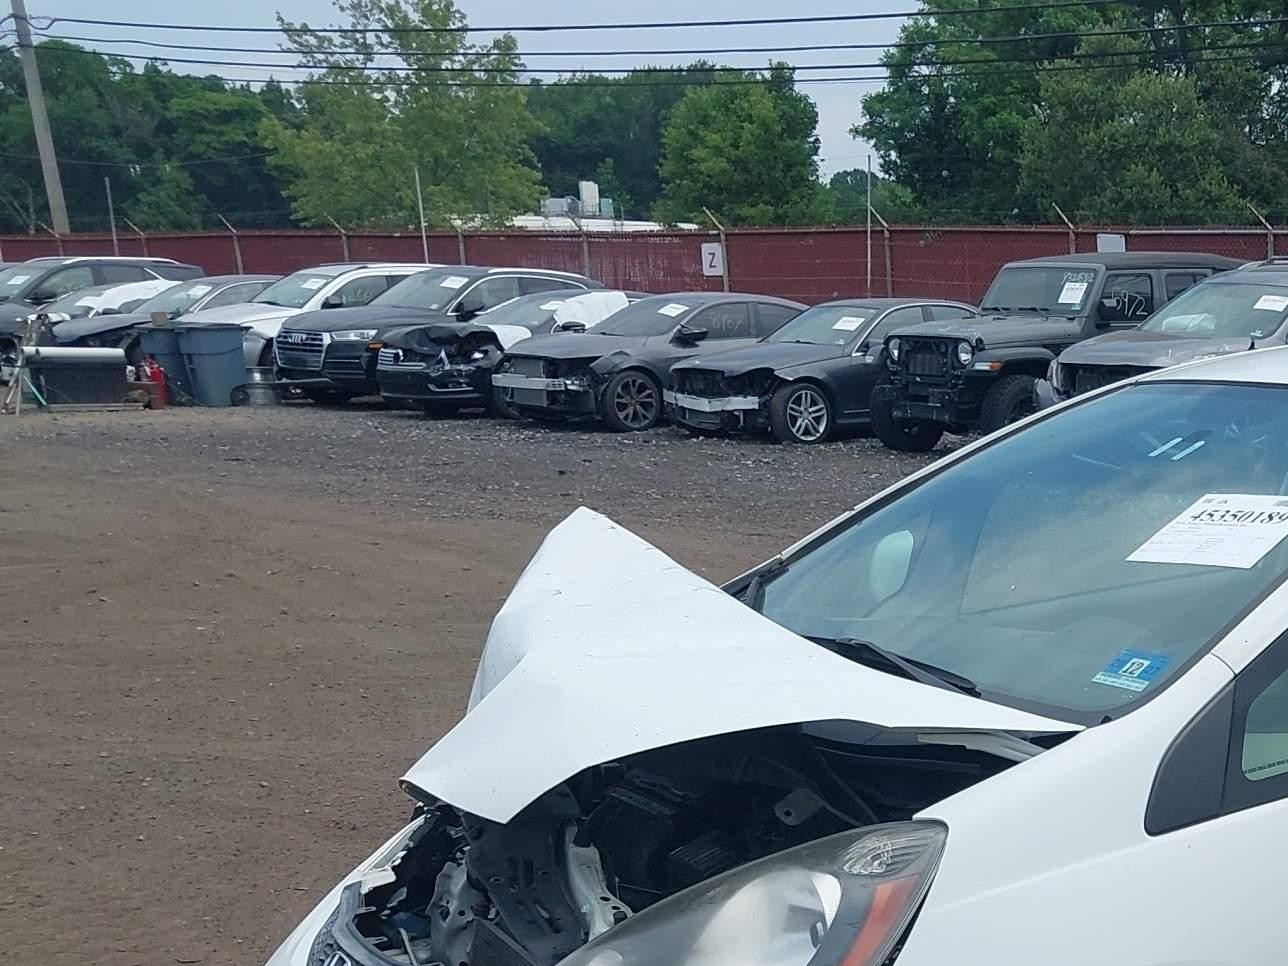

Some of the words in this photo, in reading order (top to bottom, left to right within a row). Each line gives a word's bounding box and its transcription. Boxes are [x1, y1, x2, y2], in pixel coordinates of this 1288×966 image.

[707, 252, 718, 269] Z
[1111, 287, 1148, 318] 5972
[1122, 661, 1145, 676] 12
